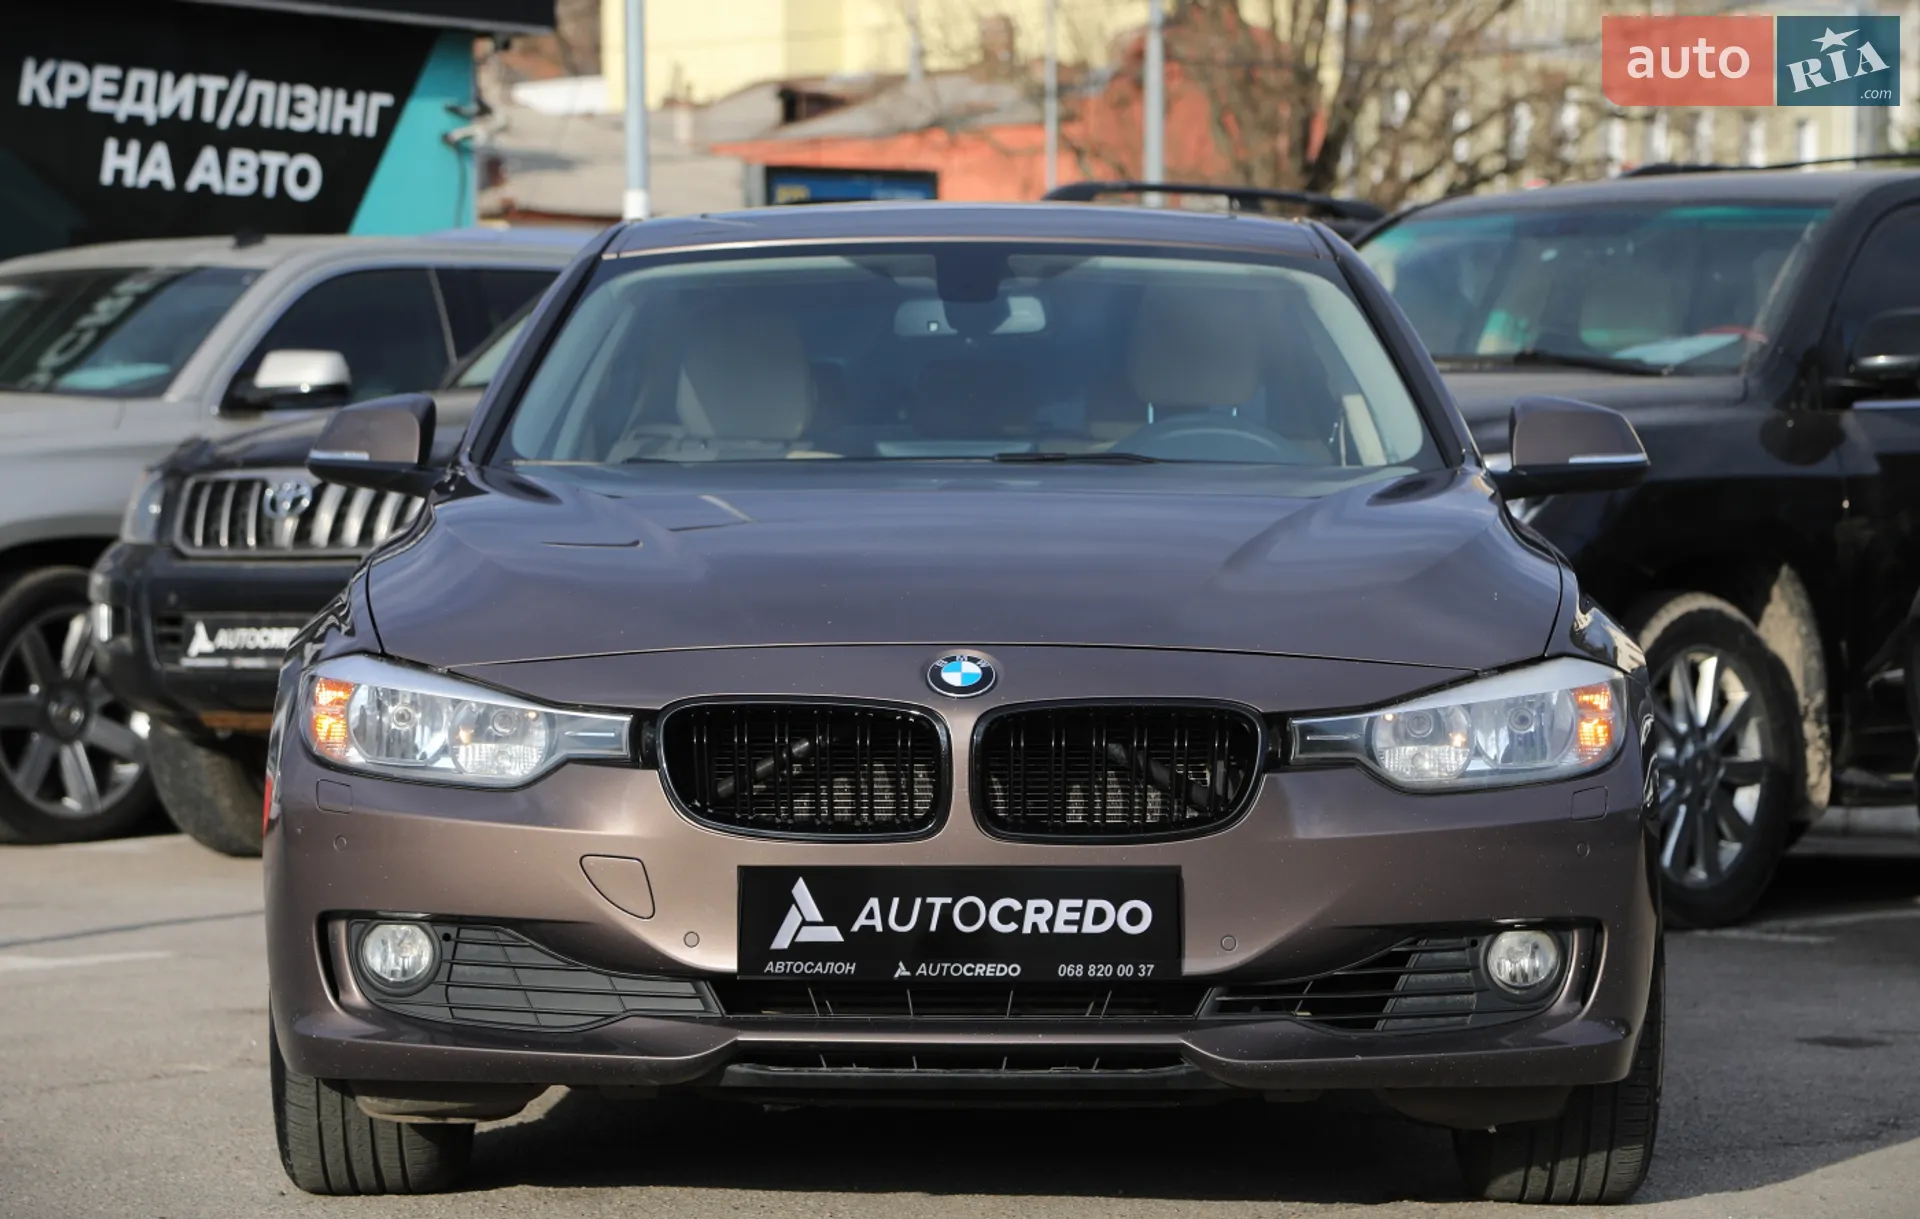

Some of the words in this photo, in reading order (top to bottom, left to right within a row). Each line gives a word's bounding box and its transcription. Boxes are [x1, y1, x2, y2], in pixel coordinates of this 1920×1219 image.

[18, 57, 394, 138] КРЕДИТ/ЛІЗІНГ
[100, 137, 175, 190] НА
[186, 146, 323, 201] АВТО
[851, 896, 1153, 935] AUTOCREDO
[764, 961, 856, 976] АВТОСАЛОН
[915, 963, 1021, 978] AUTOCREDO
[1057, 964, 1084, 978] 068
[1087, 964, 1113, 978] 820
[1116, 964, 1133, 978] 00
[1137, 964, 1155, 978] 37
